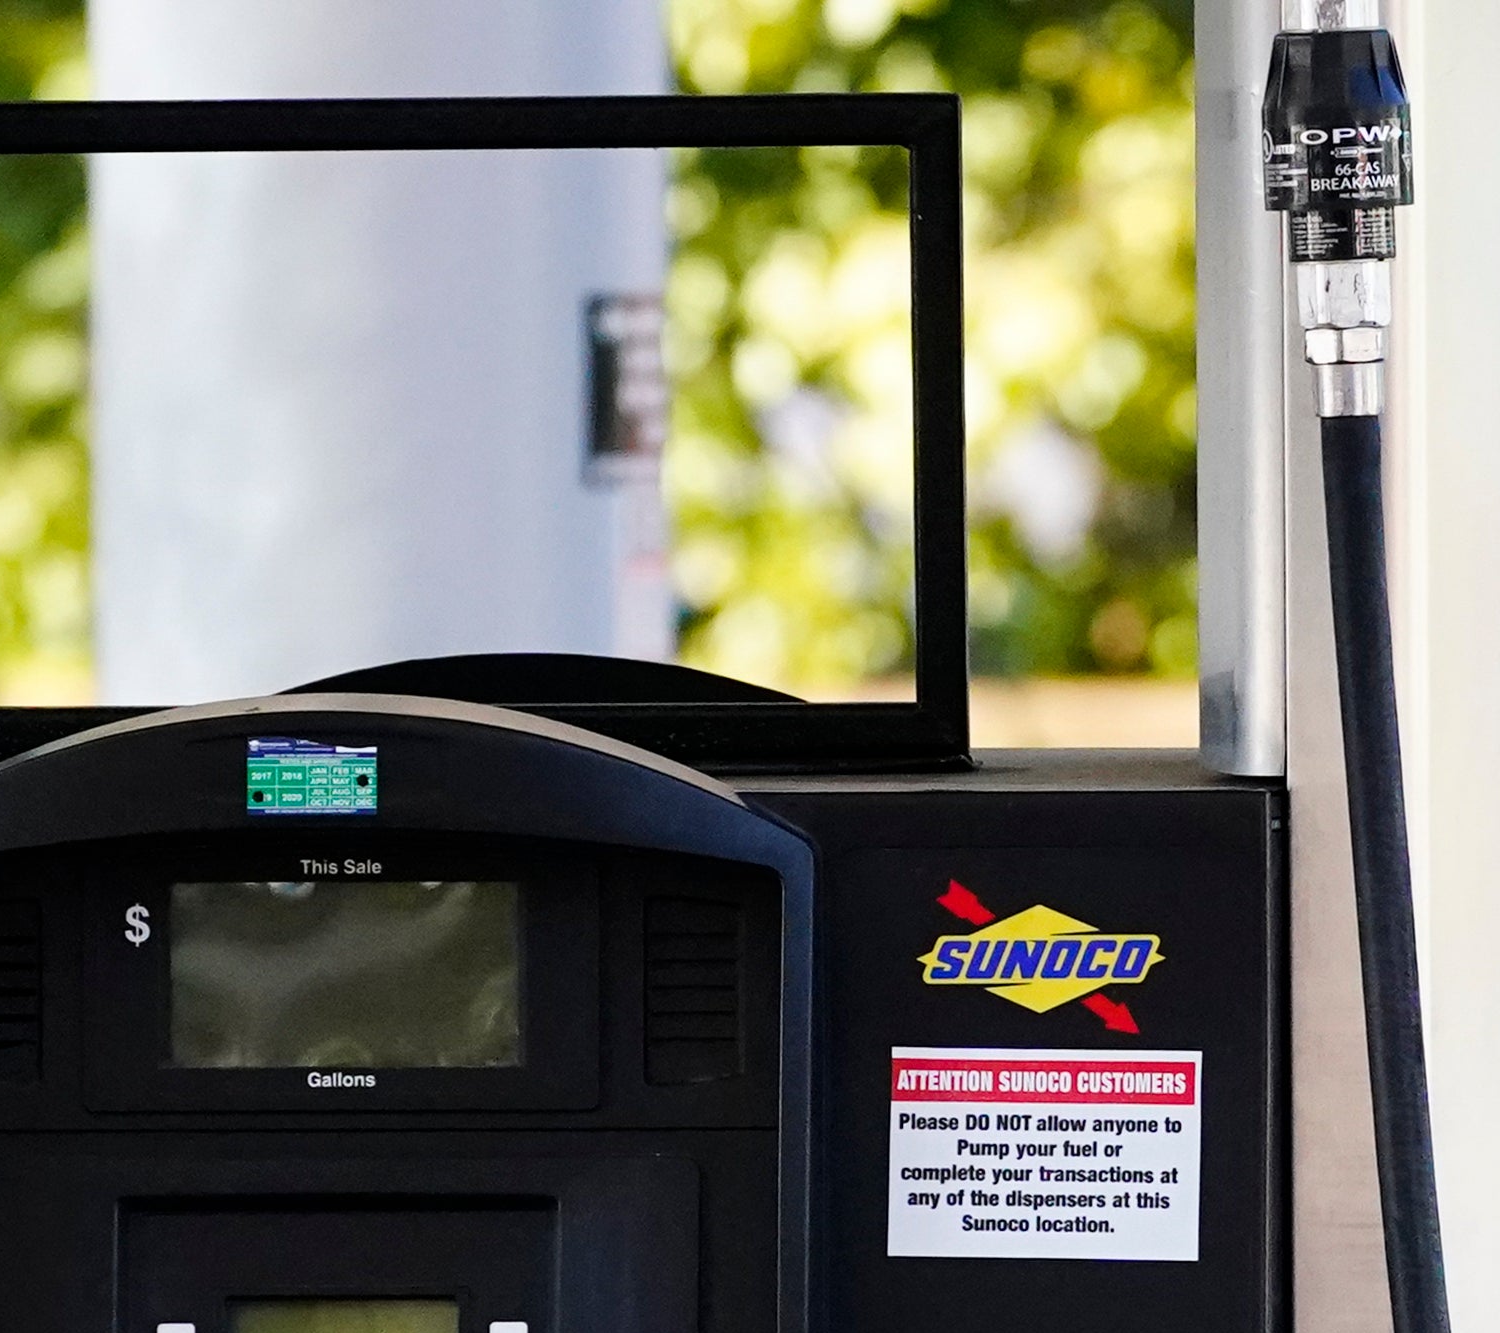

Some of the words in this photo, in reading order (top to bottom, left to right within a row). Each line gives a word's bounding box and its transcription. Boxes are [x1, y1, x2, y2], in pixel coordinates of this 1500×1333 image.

[1300, 126, 1390, 144] OPW
[1335, 161, 1380, 176] 66-CAS
[1311, 175, 1400, 191] BREAKAWAY
[301, 858, 337, 875] This
[343, 858, 382, 875] Sale
[125, 903, 150, 947] $
[930, 940, 1153, 979] SUNOCO
[307, 1070, 376, 1089] Gallons
[897, 1070, 993, 1092] ATTENTION
[999, 1071, 1072, 1093] SUNOCO
[1077, 1072, 1187, 1094] CUSTOMERS
[899, 1113, 959, 1130] Please
[965, 1114, 990, 1131] DO
[997, 1115, 1032, 1131] NOT
[1036, 1115, 1086, 1132] allow
[1092, 1118, 1158, 1136] anyone
[1165, 1117, 1182, 1133] to
[957, 1139, 1010, 1159] Pump
[1016, 1145, 1057, 1160] your
[1063, 1141, 1098, 1157] fuel
[1104, 1145, 1123, 1157] or
[901, 1165, 986, 1184] complete
[992, 1170, 1033, 1185] your
[1040, 1166, 1154, 1183] transactions
[1160, 1168, 1178, 1184] at
[907, 1193, 940, 1209] any
[946, 1190, 964, 1206] of
[971, 1190, 999, 1206] the
[1005, 1190, 1106, 1210] dispensers
[1112, 1193, 1131, 1208] at
[1136, 1192, 1170, 1208] this
[962, 1215, 1029, 1232] Sunoco
[1036, 1215, 1115, 1233] location.
